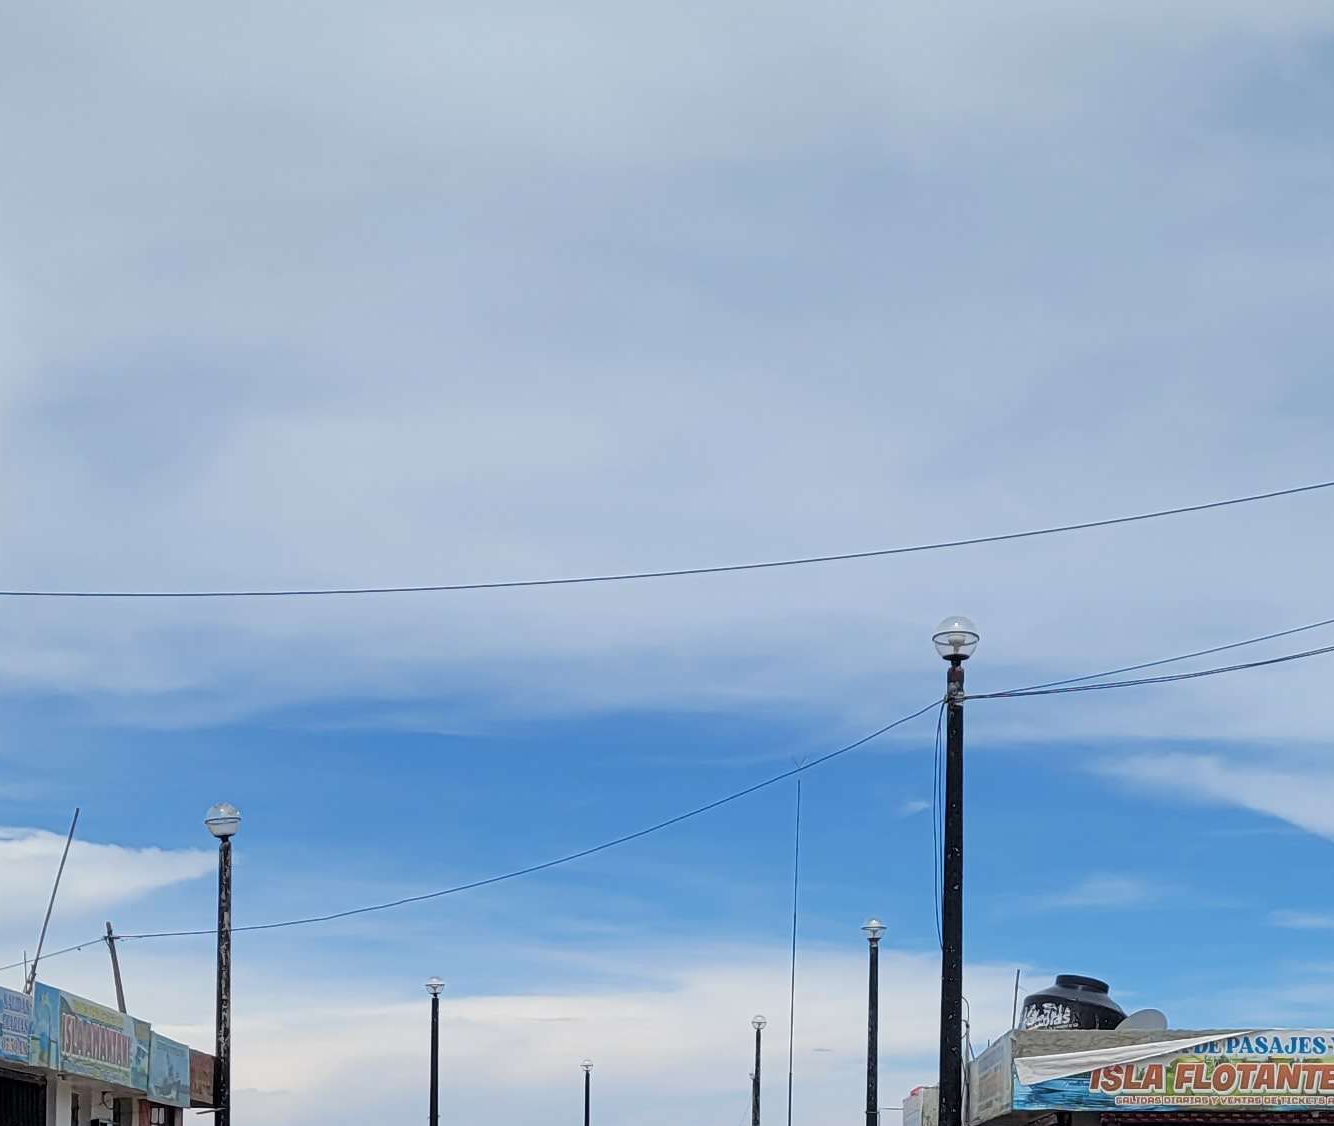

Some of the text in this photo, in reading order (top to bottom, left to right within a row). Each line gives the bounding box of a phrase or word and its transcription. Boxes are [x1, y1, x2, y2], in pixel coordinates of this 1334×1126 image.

[1226, 1036, 1328, 1055] PASAJES
[1090, 1063, 1163, 1091] ISLA
[1262, 1096, 1277, 1105] DE
